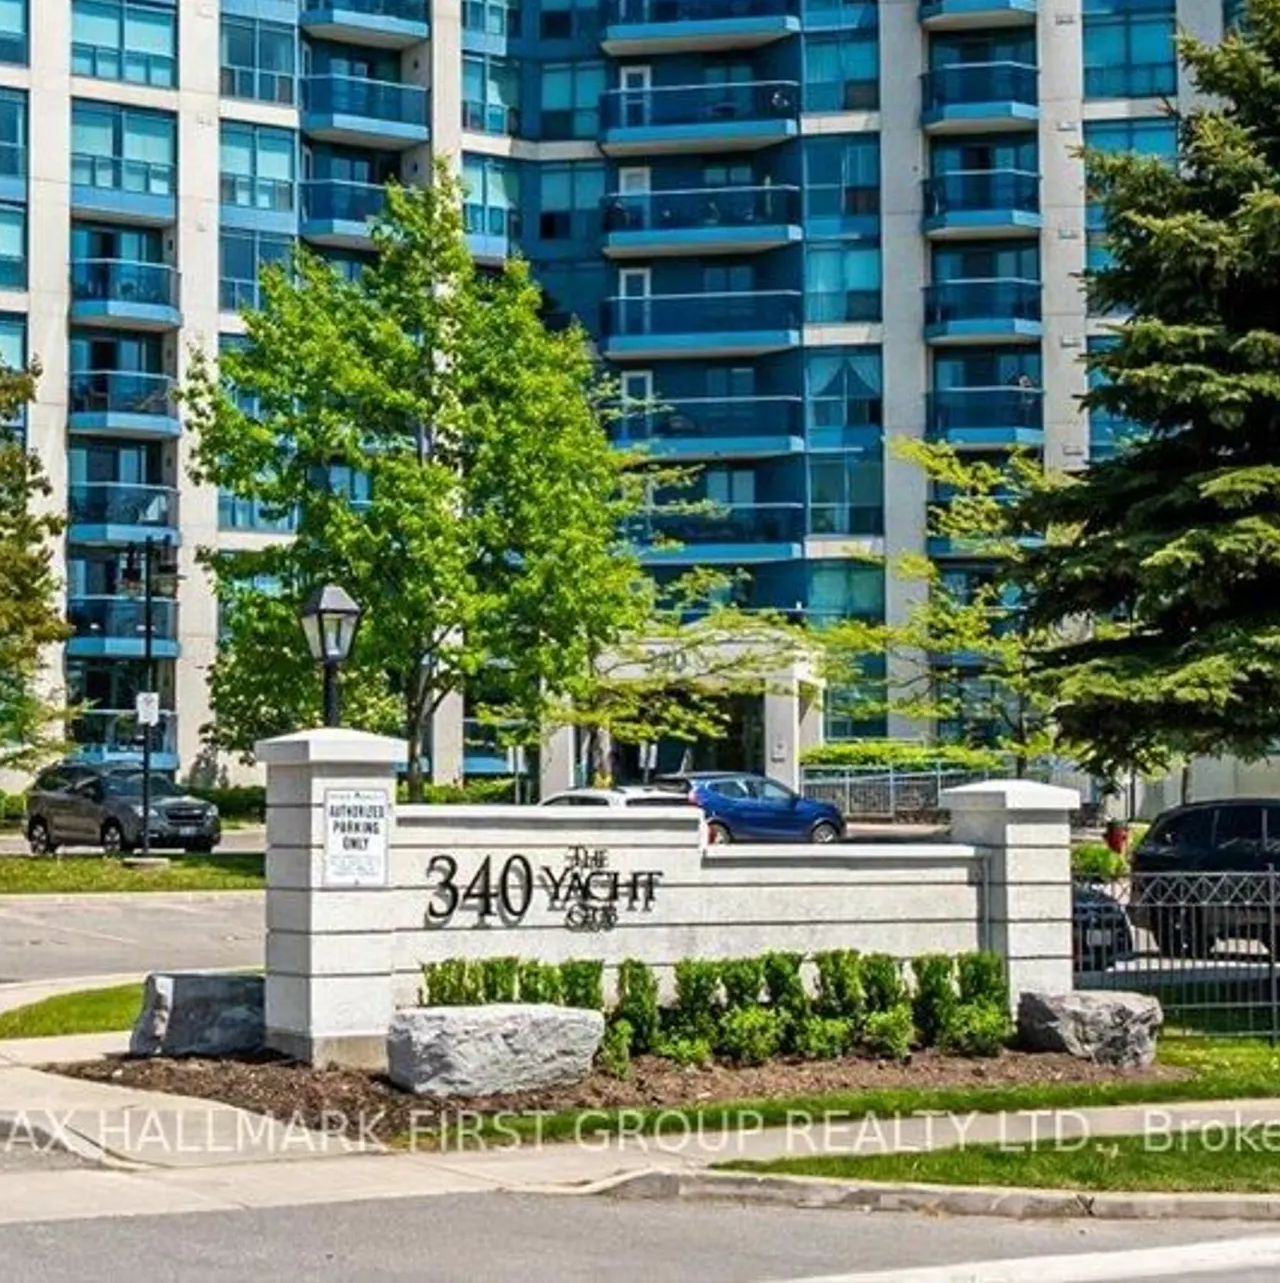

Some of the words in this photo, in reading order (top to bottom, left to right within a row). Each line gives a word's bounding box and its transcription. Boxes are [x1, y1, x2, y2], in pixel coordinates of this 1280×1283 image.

[330, 804, 384, 818] AUTHORIZED
[332, 820, 380, 835] PARKING
[342, 836, 369, 851] ONLY
[427, 854, 534, 918] 340
[541, 866, 663, 902] YACHT
